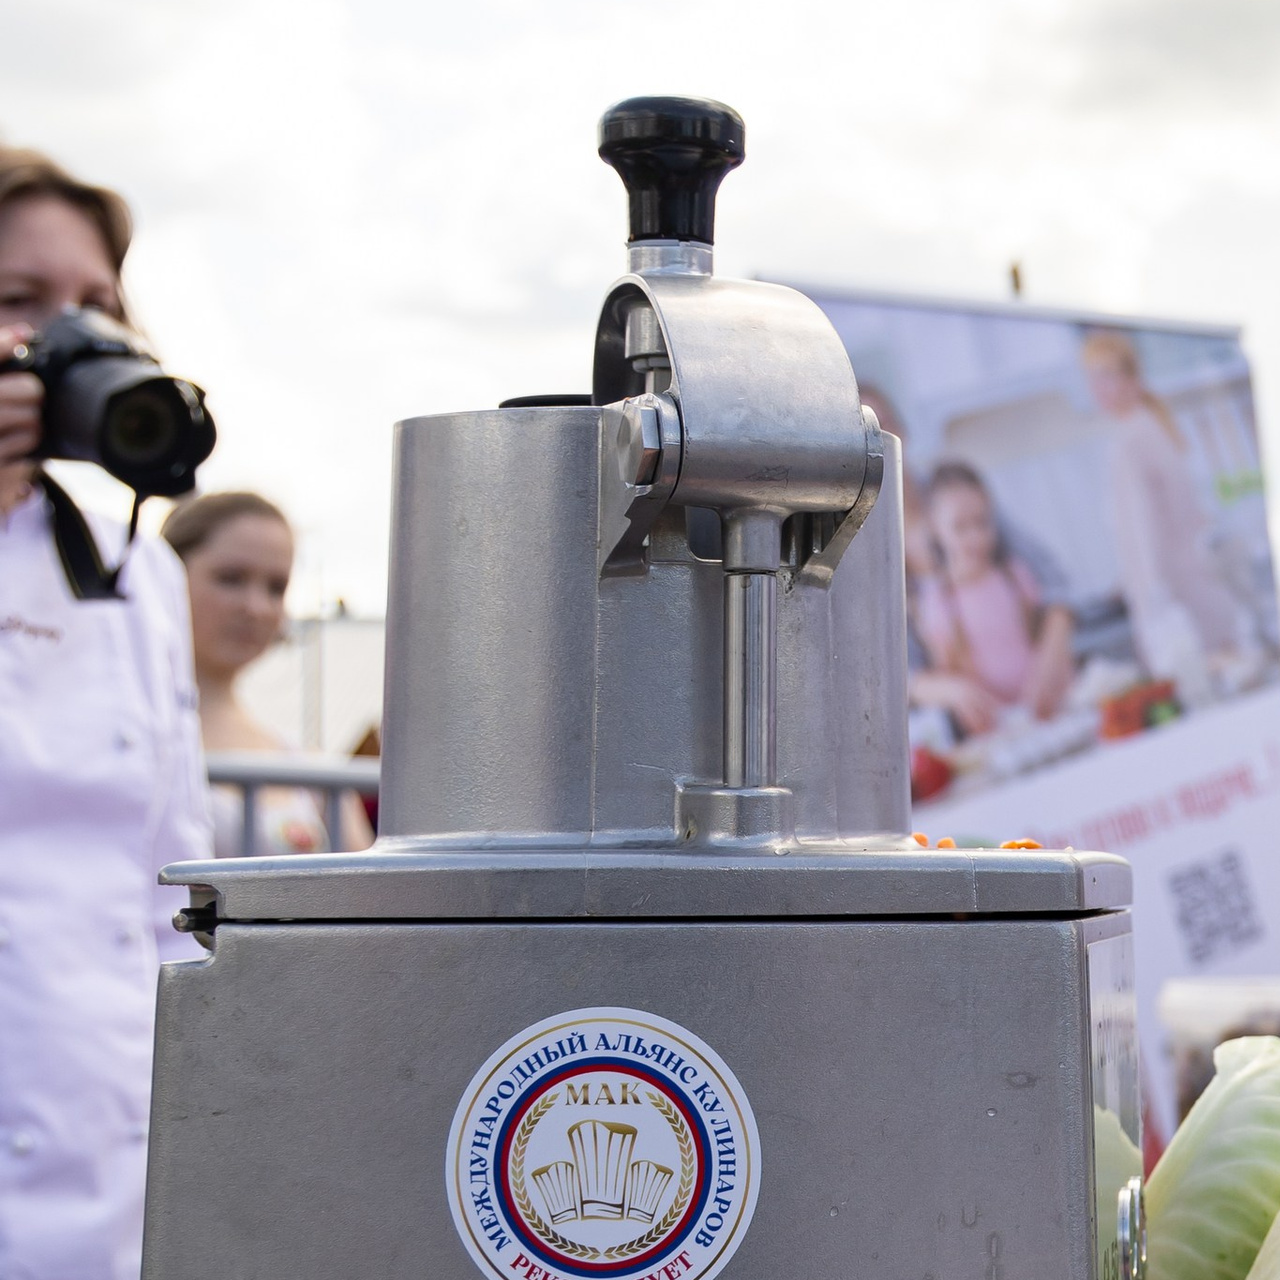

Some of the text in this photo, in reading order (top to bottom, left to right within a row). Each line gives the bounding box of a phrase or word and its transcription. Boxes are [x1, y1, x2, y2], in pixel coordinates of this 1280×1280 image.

[469, 1031, 588, 1253] МЕЖДУНАРОДНЫЙ
[594, 1032, 699, 1085] АЛЬЯНС
[564, 1081, 643, 1106] МАК
